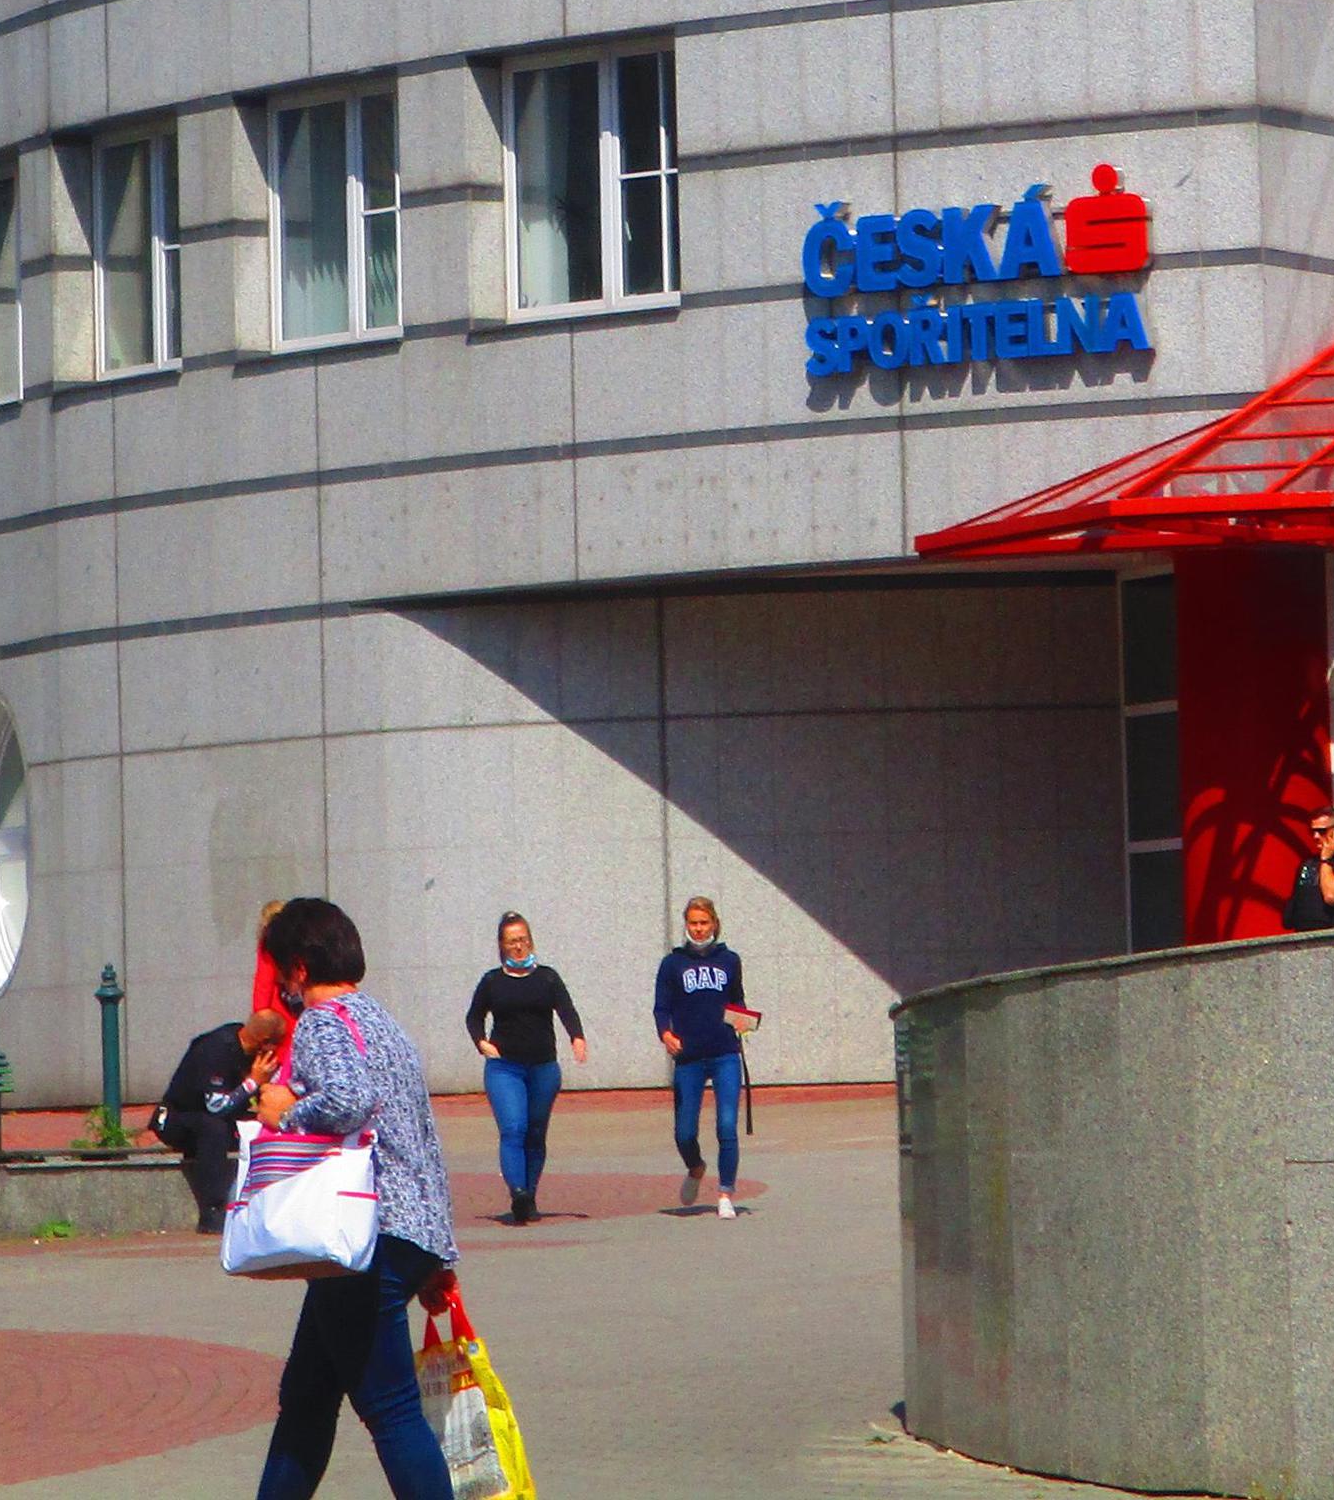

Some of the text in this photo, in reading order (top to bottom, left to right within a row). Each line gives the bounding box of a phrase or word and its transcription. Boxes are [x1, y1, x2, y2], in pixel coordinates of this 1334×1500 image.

[802, 183, 1061, 298] ČESKÁ
[805, 293, 1150, 378] SPOŘITELNA
[682, 966, 728, 993] GAP
